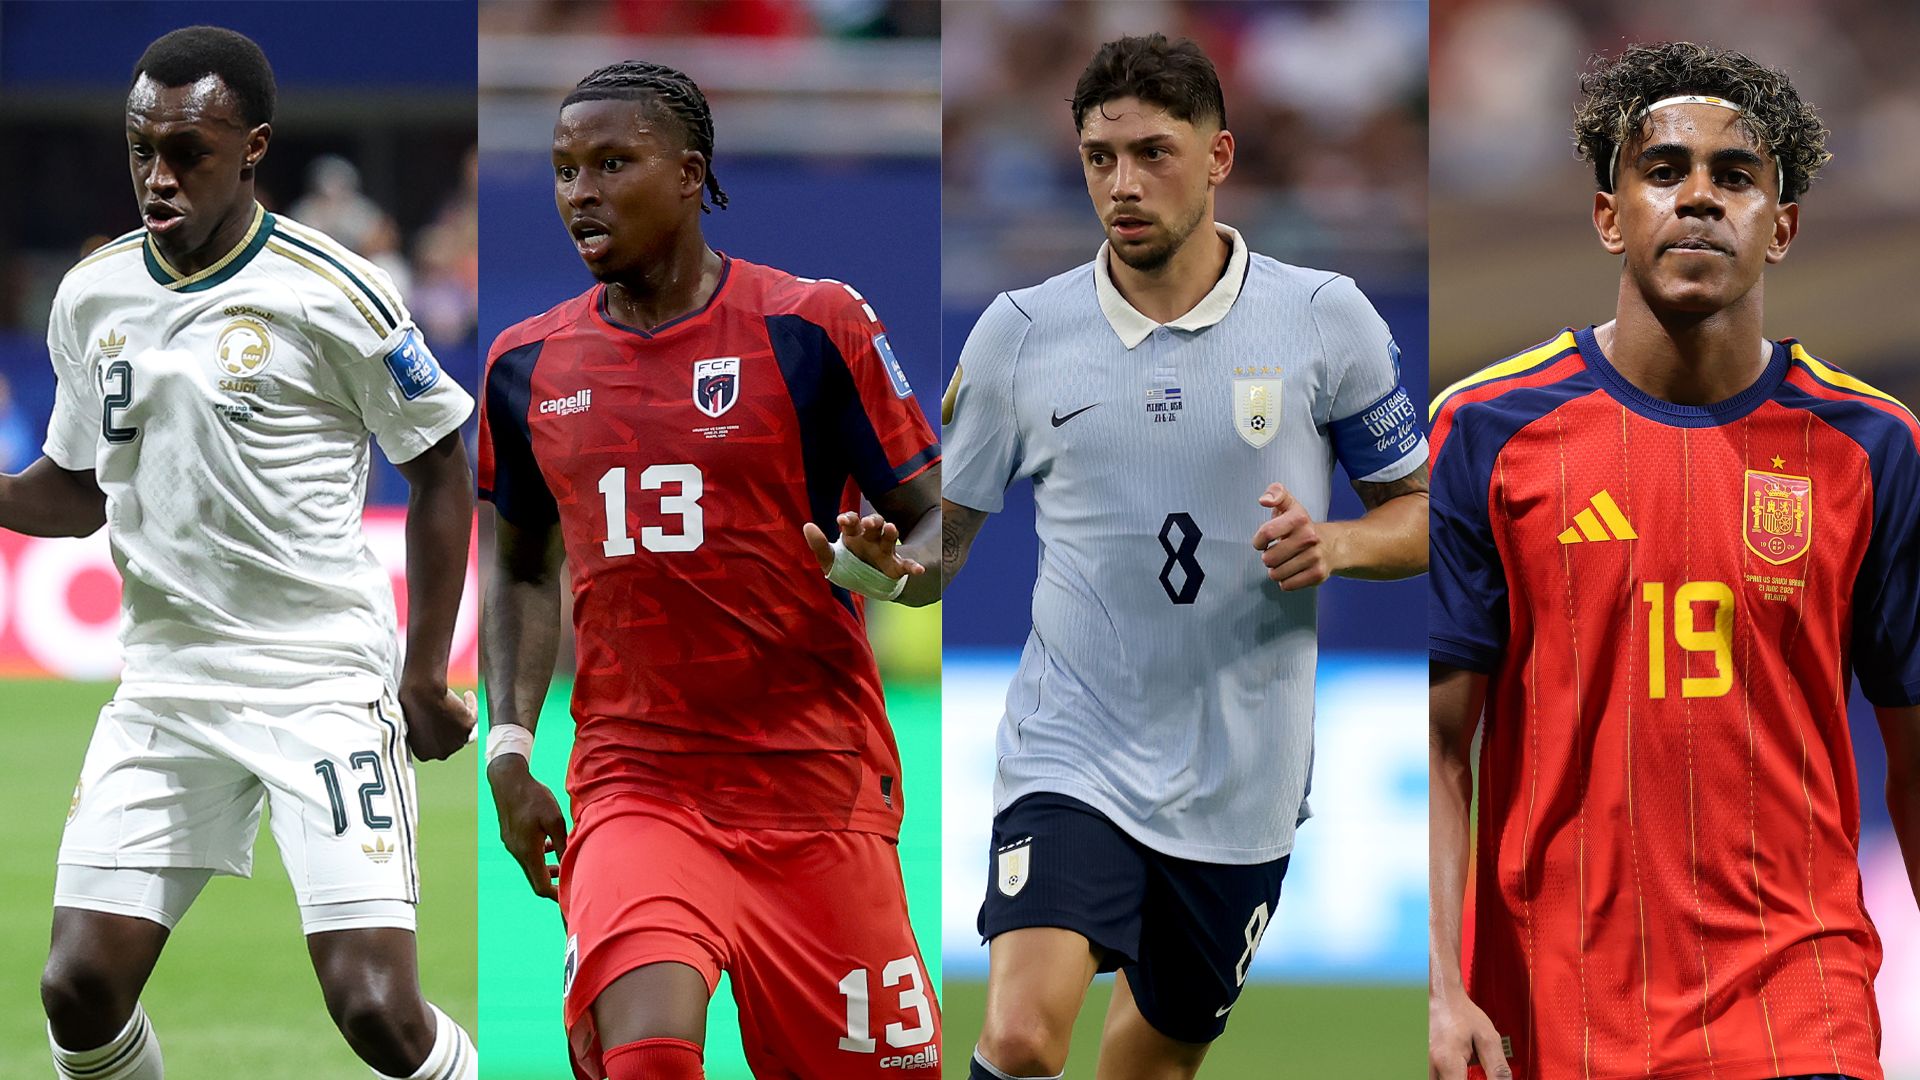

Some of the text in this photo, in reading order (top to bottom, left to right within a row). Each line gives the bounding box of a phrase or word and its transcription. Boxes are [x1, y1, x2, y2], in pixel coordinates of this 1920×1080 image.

[698, 360, 736, 373] FCF
[219, 379, 257, 394] SAUDI
[539, 388, 592, 416] capelli
[561, 405, 591, 416] SPORT
[1362, 389, 1407, 426] FOOTBALL
[1368, 397, 1414, 438] UNITES
[1373, 434, 1397, 452] the
[1399, 435, 1416, 452] FIFA
[598, 463, 704, 558] 13
[1158, 511, 1205, 605] 8
[1642, 581, 1734, 699] 19
[314, 750, 393, 836] 12
[1235, 901, 1269, 988] 8
[838, 954, 935, 1054] 13
[879, 1044, 938, 1070] capelli
[907, 1060, 938, 1070] SPORT
